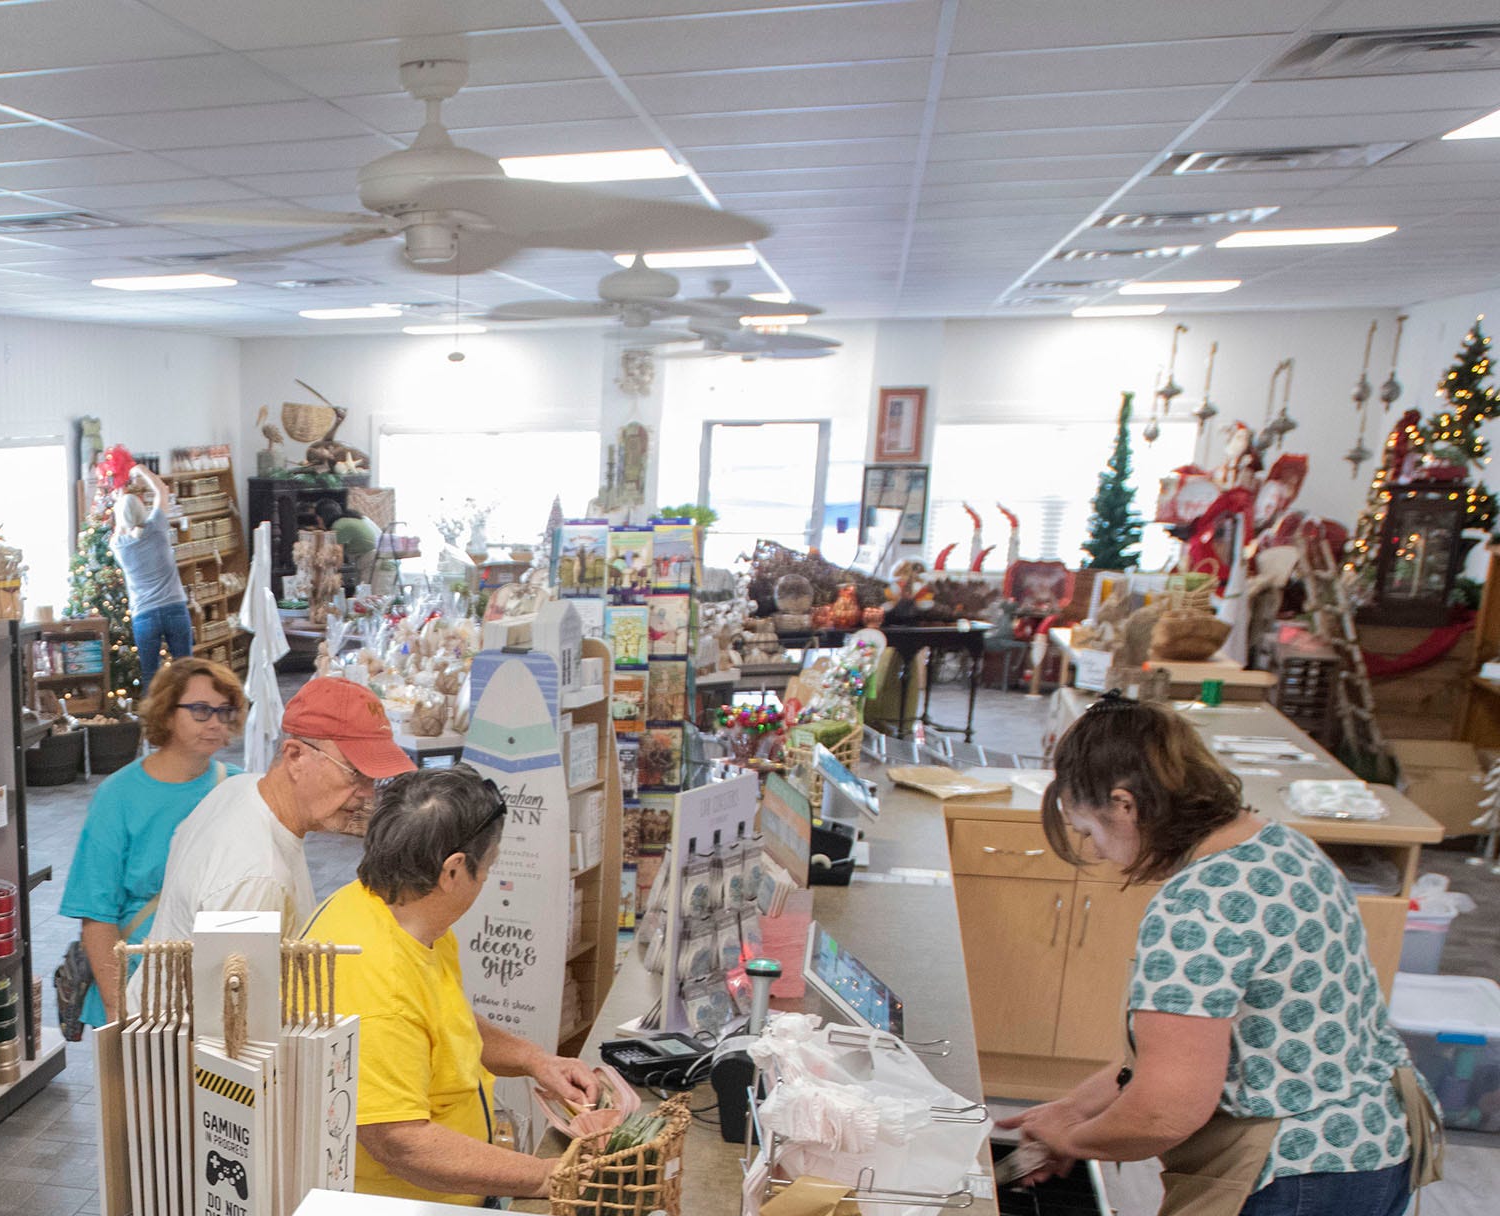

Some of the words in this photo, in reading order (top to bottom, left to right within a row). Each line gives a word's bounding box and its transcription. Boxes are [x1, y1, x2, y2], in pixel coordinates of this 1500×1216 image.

[511, 809, 542, 825] NN
[484, 915, 535, 942] home
[481, 955, 525, 988] gifts
[326, 1032, 355, 1192] HOM
[203, 1111, 250, 1146] GAMING
[205, 1130, 213, 1143] IN
[213, 1134, 249, 1159] PROGRESS
[207, 1192, 221, 1212] DO
